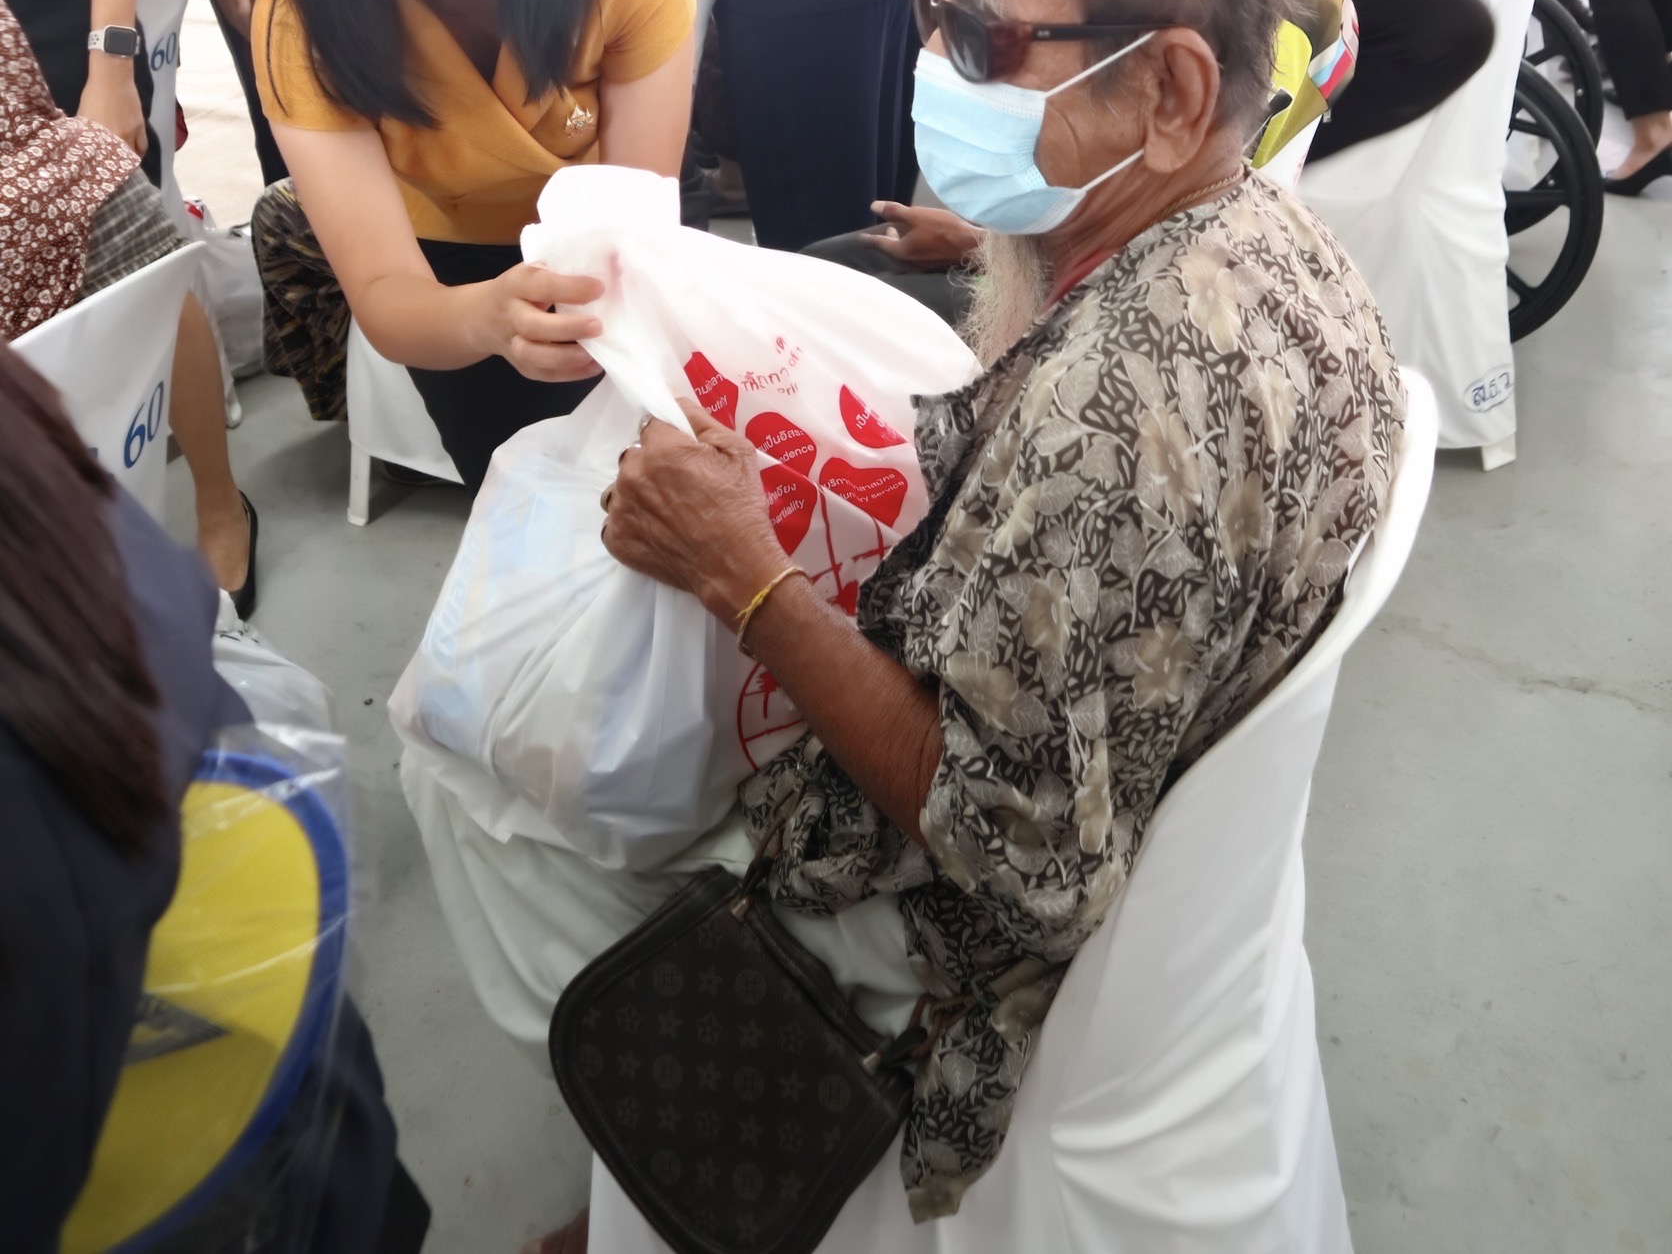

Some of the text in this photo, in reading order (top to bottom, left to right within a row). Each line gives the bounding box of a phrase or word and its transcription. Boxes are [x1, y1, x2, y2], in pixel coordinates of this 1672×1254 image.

[150, 31, 177, 72] 60
[123, 380, 164, 469] 60
[870, 480, 905, 499] service
